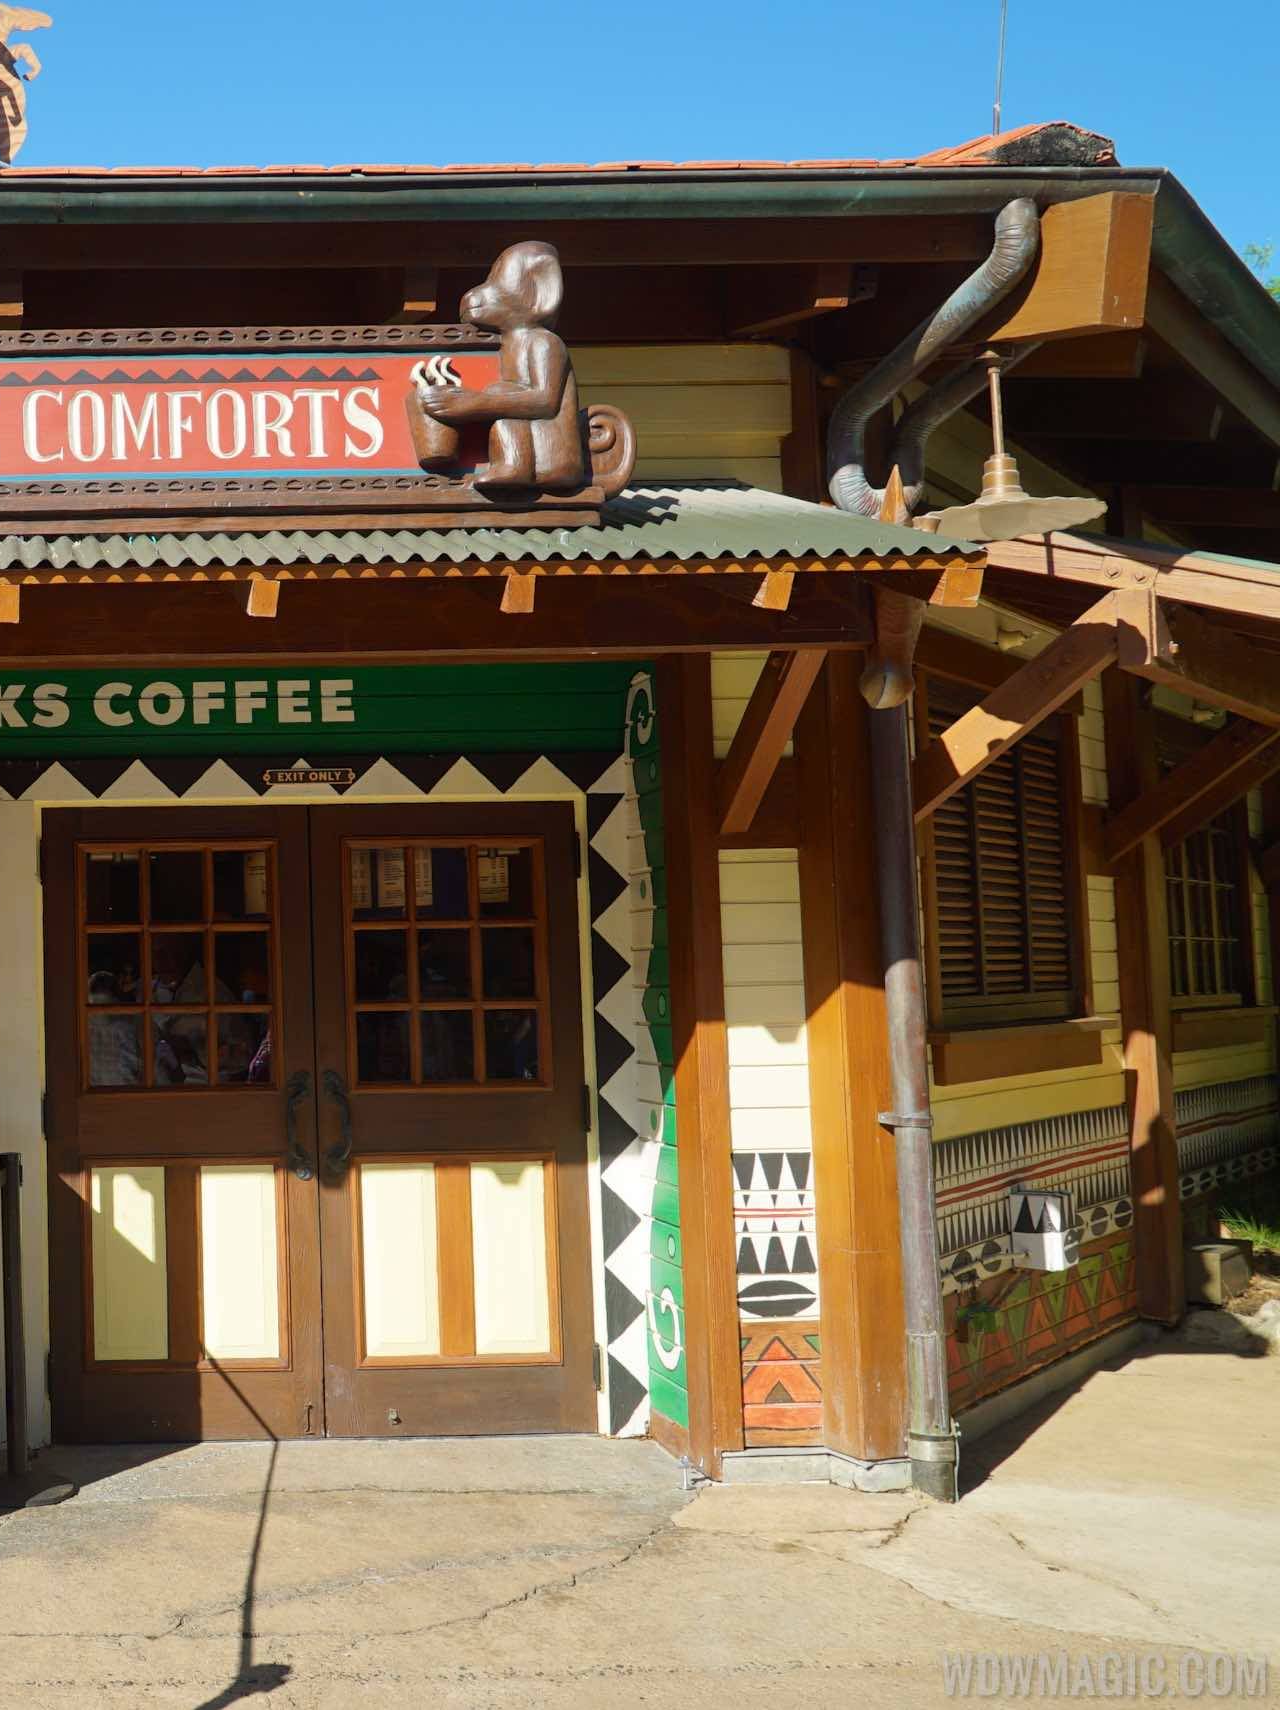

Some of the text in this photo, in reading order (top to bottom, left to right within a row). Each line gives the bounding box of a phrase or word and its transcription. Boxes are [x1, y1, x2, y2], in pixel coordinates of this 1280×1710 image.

[22, 386, 384, 463] COMFORTS
[93, 679, 355, 727] COFFEE
[277, 771, 341, 782] EXIT ONLY
